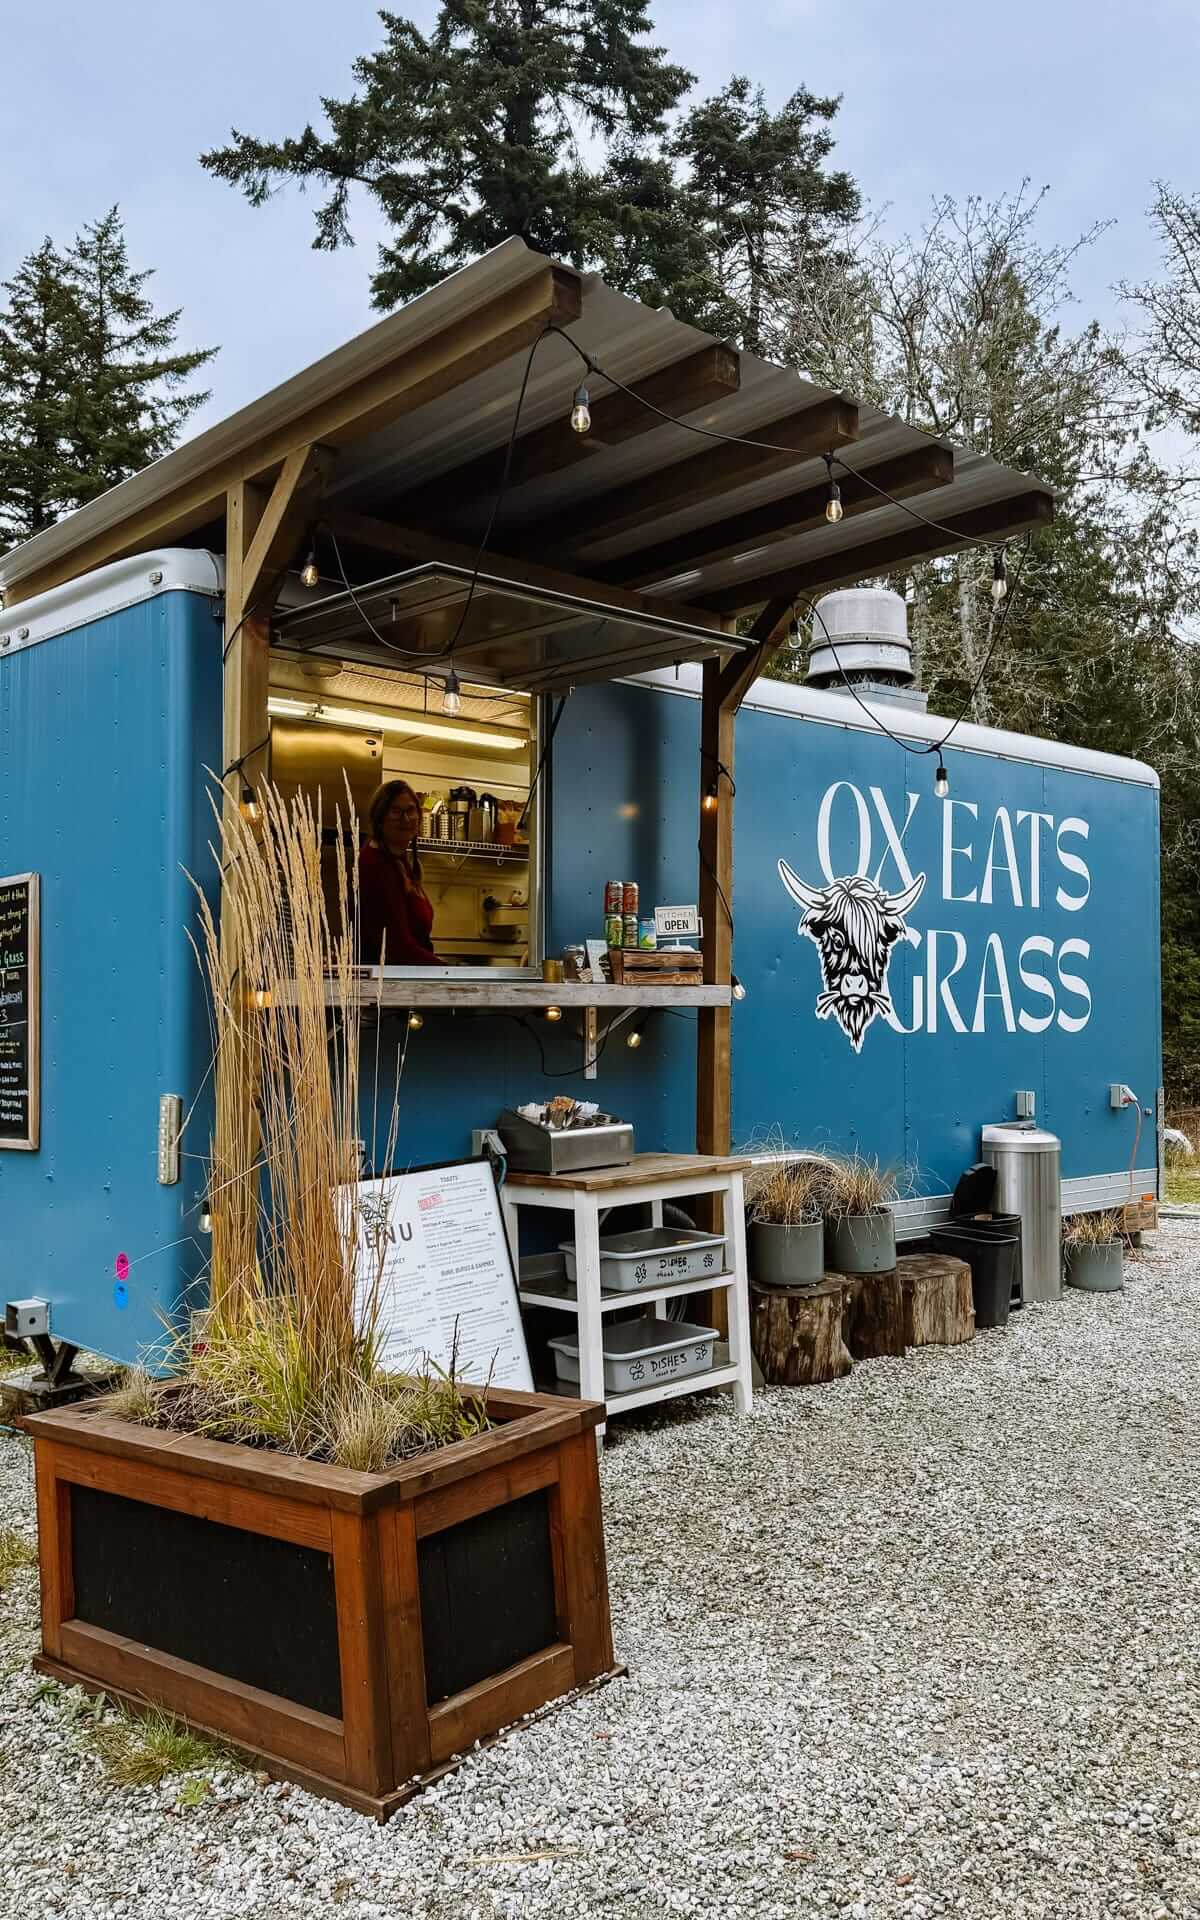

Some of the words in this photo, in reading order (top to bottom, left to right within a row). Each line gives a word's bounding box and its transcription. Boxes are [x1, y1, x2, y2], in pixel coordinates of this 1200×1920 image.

[817, 781, 920, 889] OX
[943, 798, 1091, 912] EATS
[658, 911, 694, 919] KITCHEN
[664, 919, 689, 931] OPEN
[882, 926, 1091, 1033] GRASS
[651, 1353, 687, 1372] DISHES
